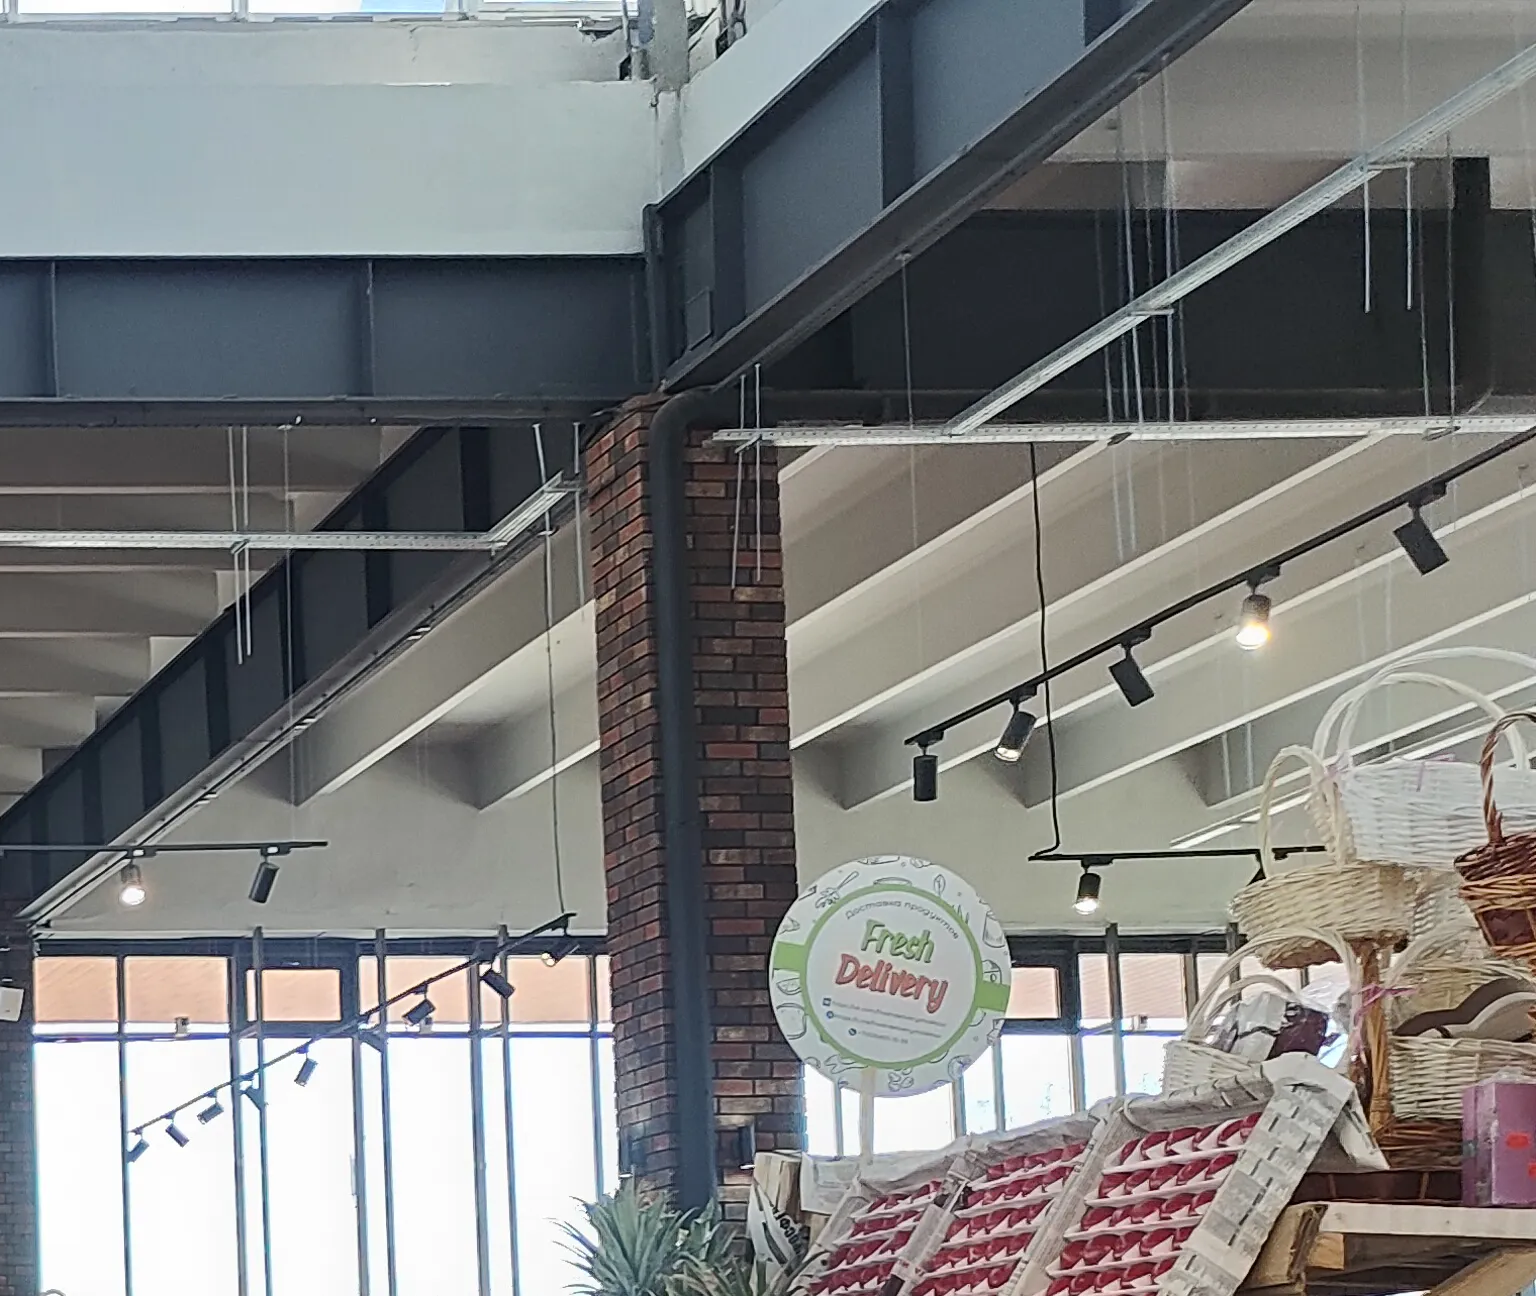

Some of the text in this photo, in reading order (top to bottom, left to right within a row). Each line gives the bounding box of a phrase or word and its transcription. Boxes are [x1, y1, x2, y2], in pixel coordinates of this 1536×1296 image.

[845, 900, 902, 920] Доставка
[860, 919, 935, 963] Fresh
[834, 953, 949, 1014] Delivery
